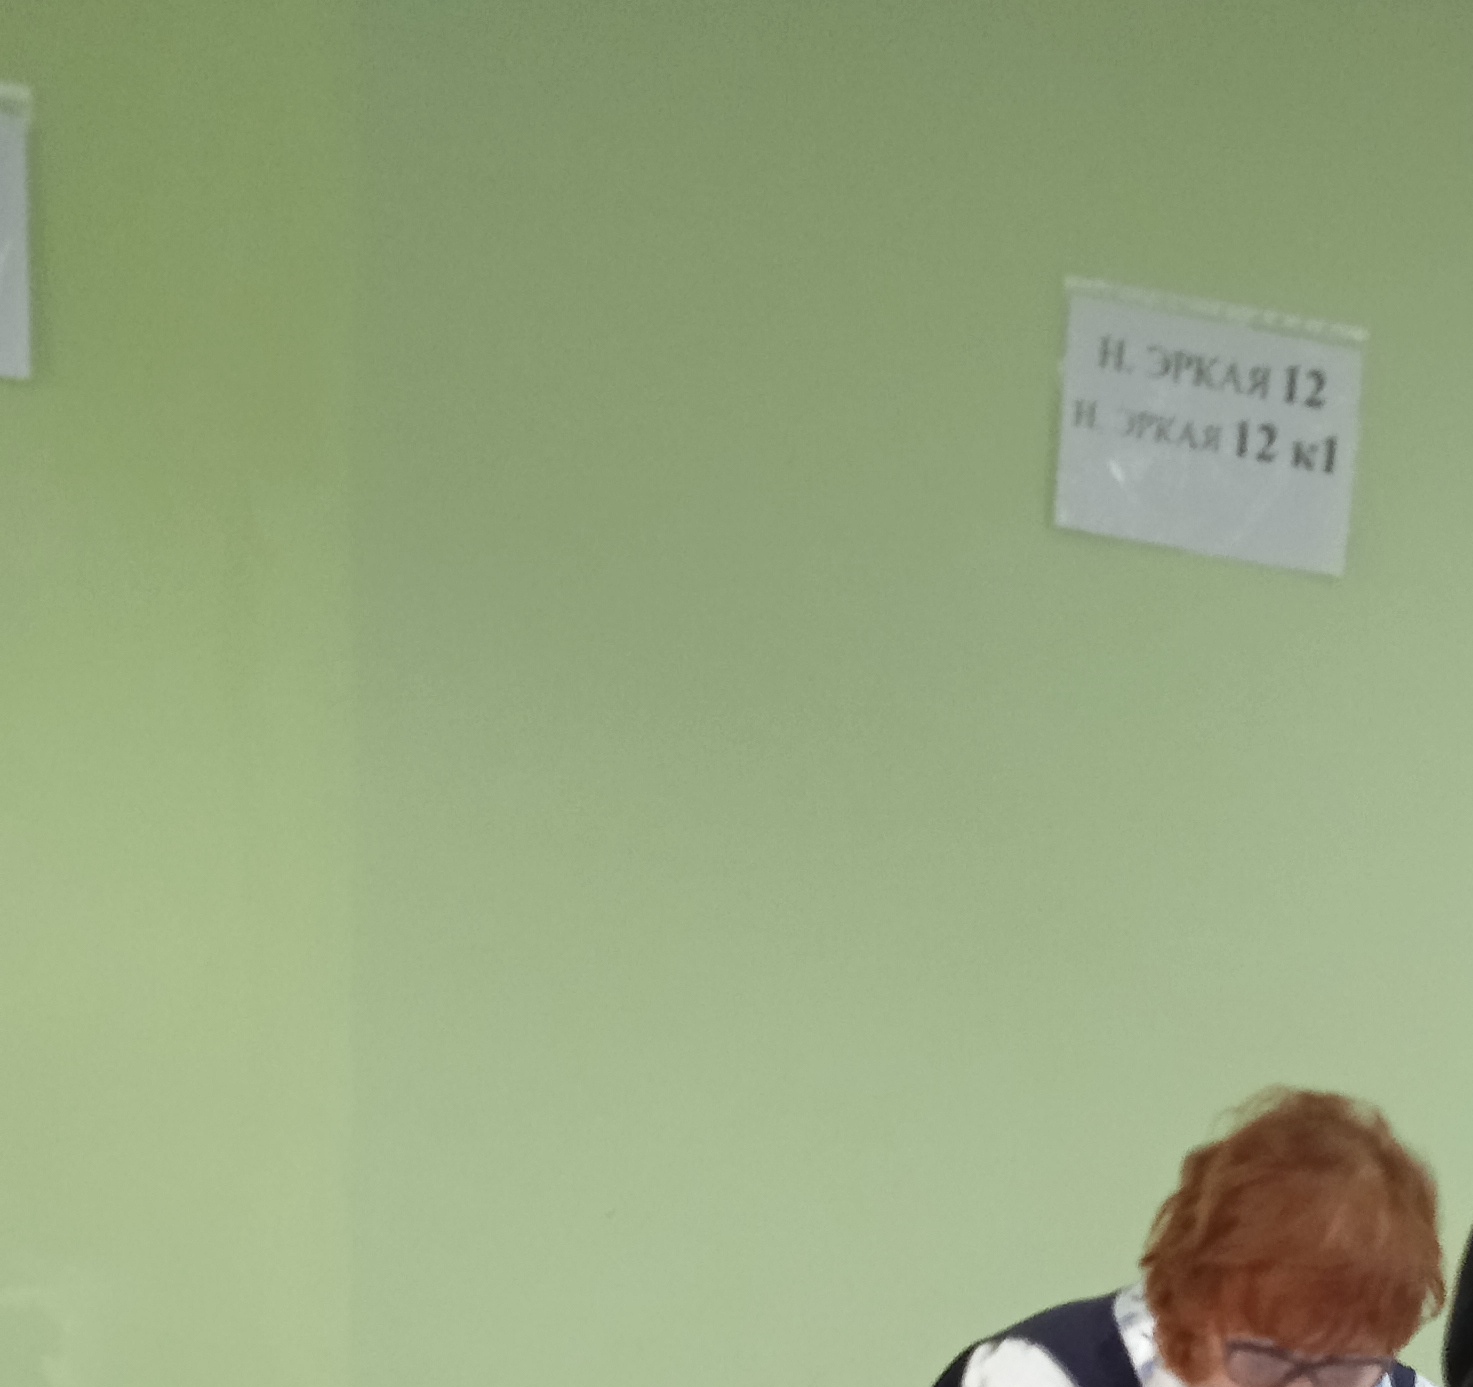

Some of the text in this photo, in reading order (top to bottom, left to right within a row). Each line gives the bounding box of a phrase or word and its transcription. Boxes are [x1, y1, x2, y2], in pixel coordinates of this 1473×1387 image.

[1097, 333, 1327, 409] Н. ЭРКАЯ 12
[1235, 419, 1278, 463] 12
